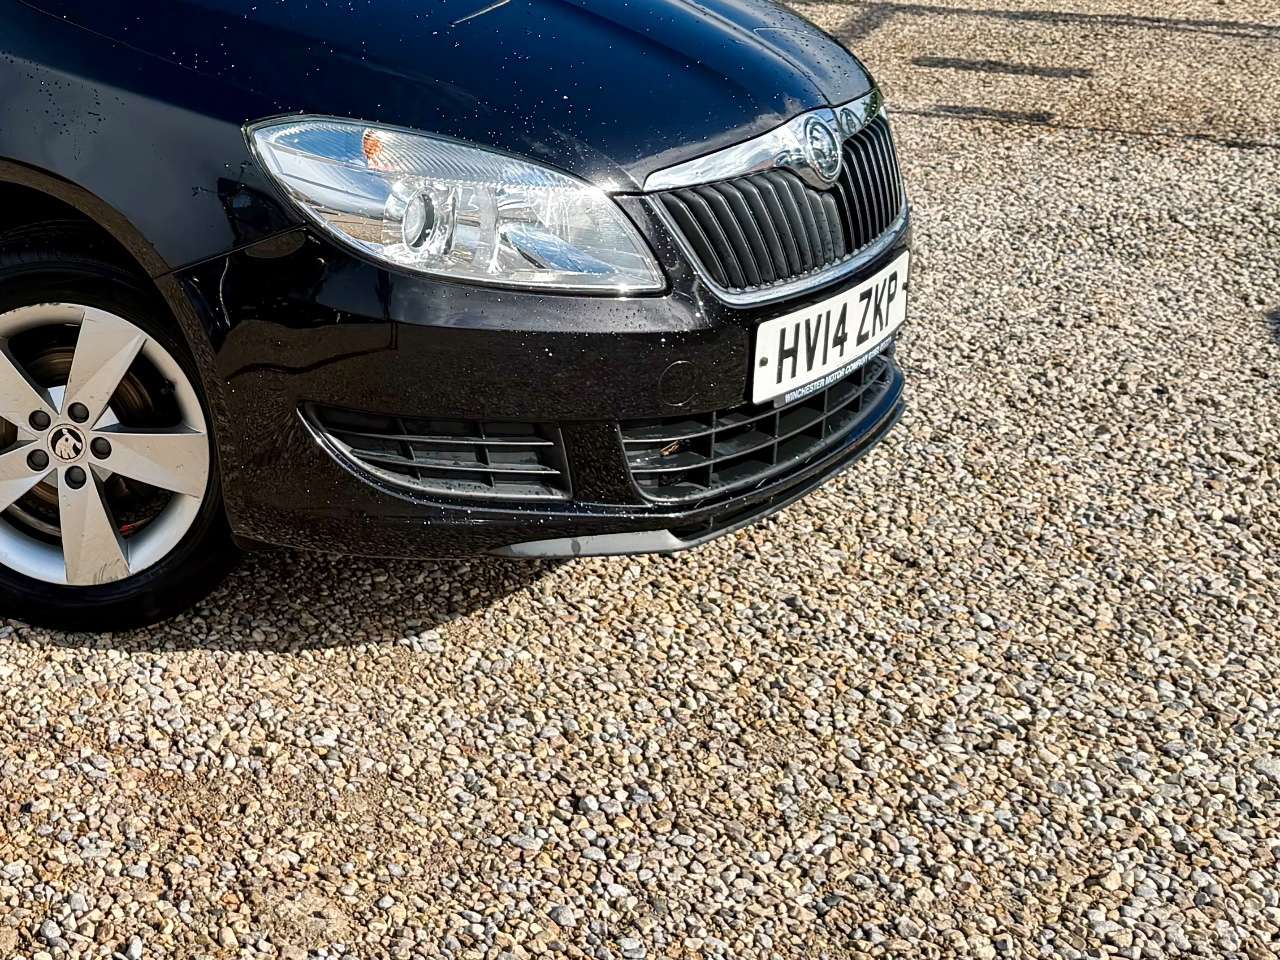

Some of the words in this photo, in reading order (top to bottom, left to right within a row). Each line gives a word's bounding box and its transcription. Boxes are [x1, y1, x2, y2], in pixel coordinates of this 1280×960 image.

[776, 302, 849, 385] HV14
[856, 271, 898, 347] ZKP
[785, 378, 825, 404] WINCHESTER
